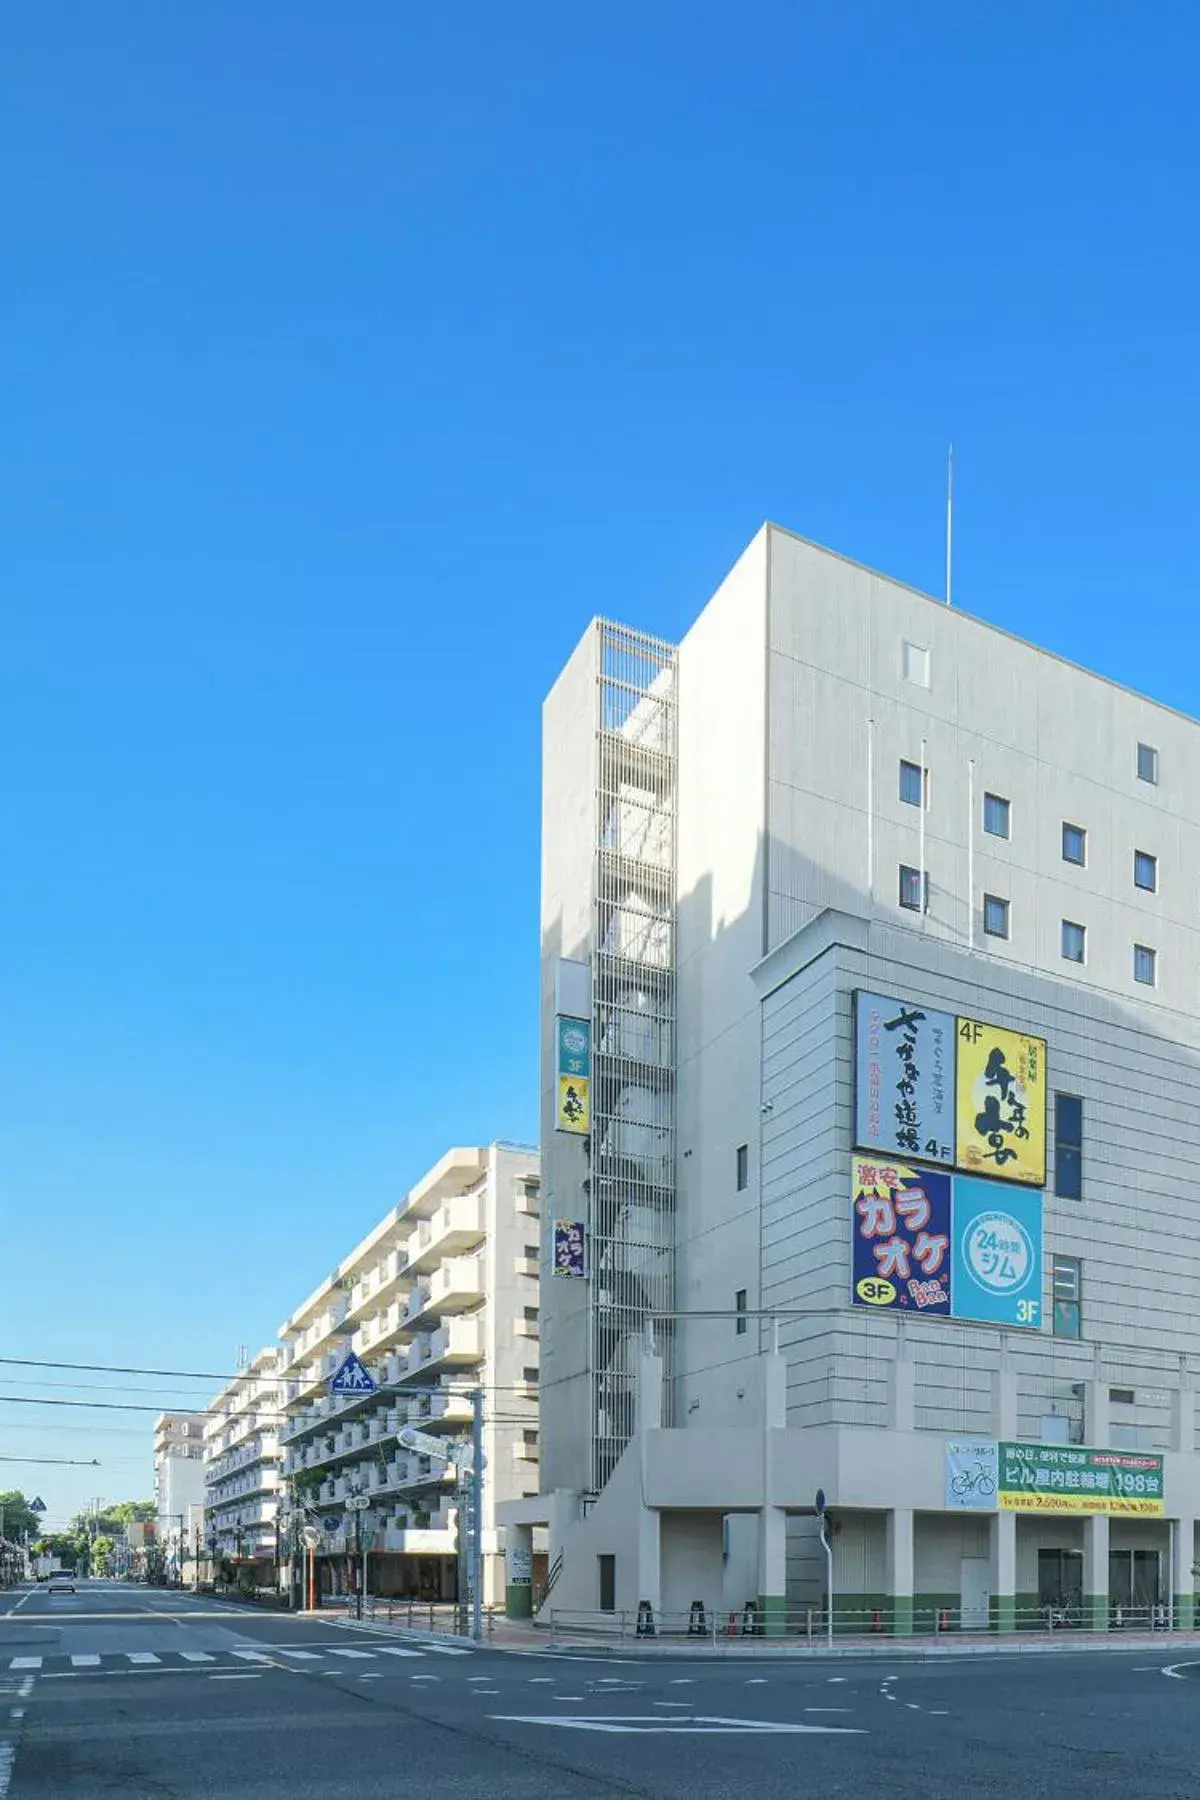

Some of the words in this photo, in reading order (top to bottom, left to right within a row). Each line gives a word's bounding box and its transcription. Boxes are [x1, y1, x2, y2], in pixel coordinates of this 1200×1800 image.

[960, 1022, 983, 1045] 4F
[568, 1059, 584, 1073] 3F
[925, 1137, 951, 1159] 4F
[980, 1252, 1017, 1279] ジム
[863, 1282, 890, 1300] 3F
[1016, 1299, 1039, 1322] 3F
[1115, 1473, 1160, 1493] 198台
